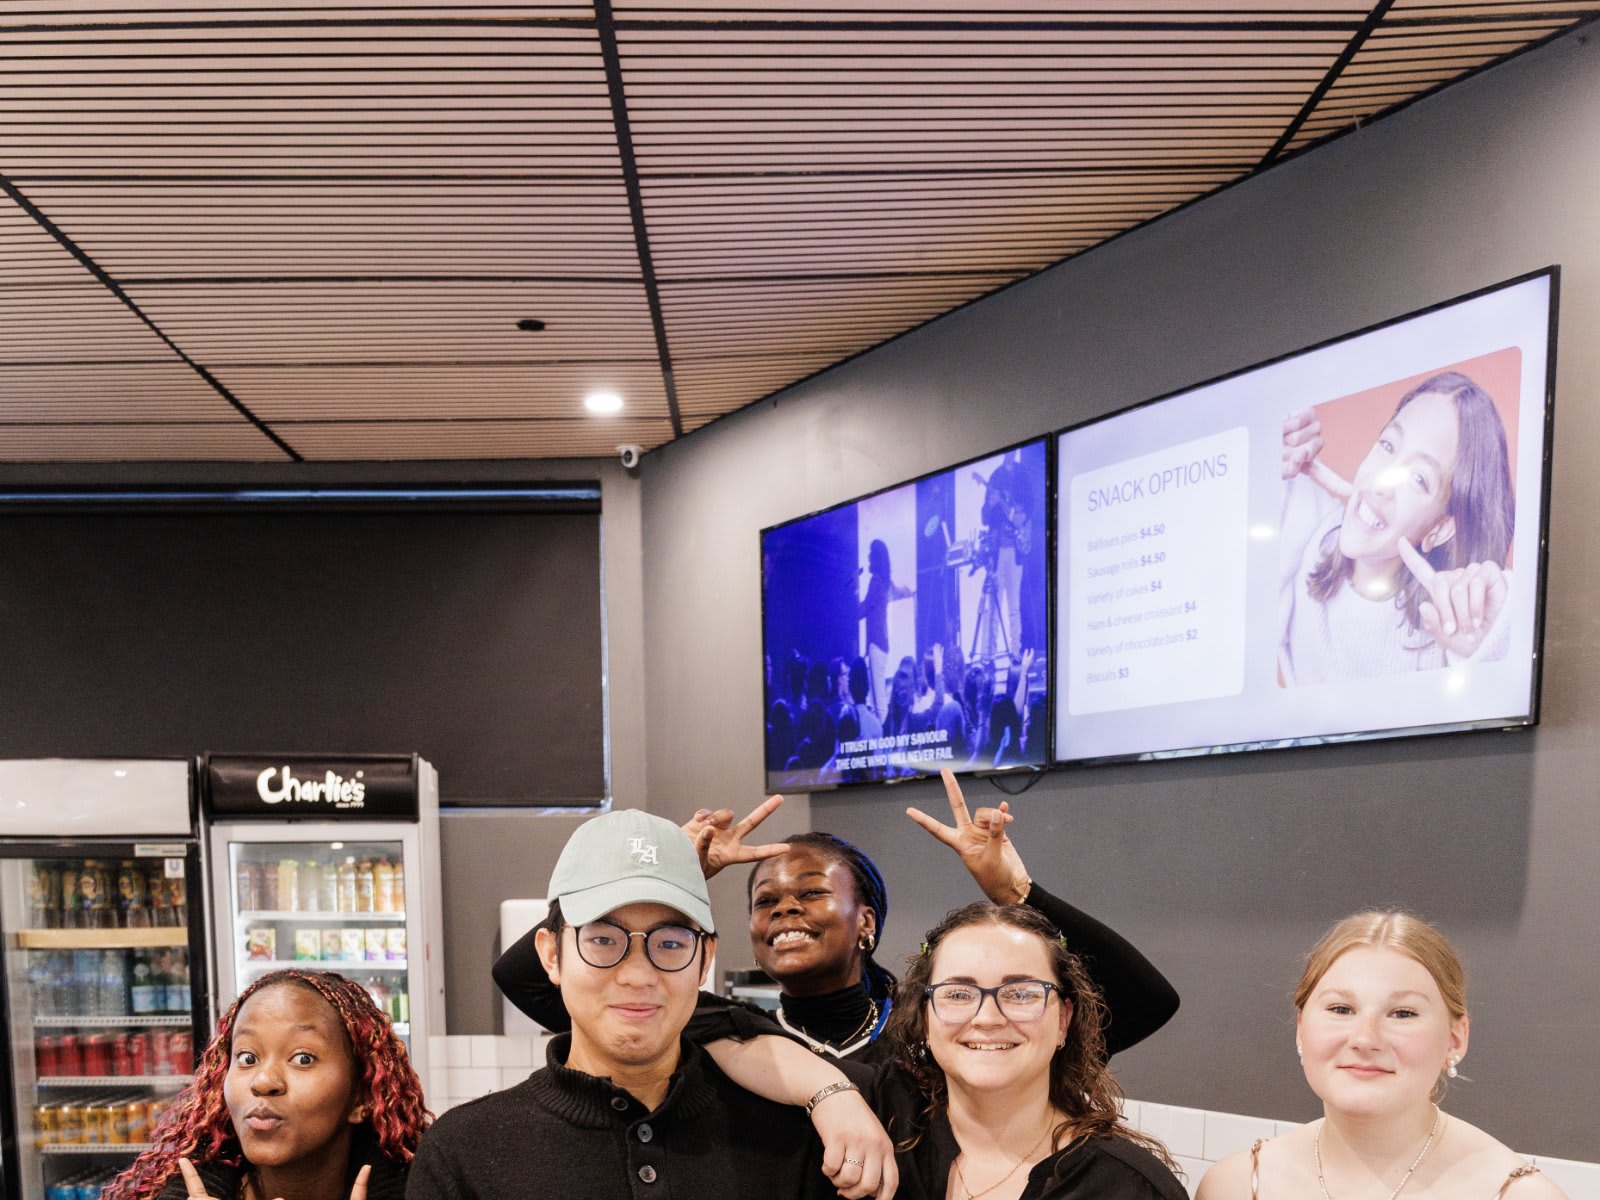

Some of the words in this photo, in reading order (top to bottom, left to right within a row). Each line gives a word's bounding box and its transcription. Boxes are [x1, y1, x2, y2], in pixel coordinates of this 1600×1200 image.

[1087, 477, 1144, 512] SNACK
[1148, 453, 1228, 496] OPTIONS
[1140, 523, 1165, 539] $4.50
[1088, 563, 1120, 578] Sausage
[1121, 558, 1139, 570] rolls
[1140, 551, 1165, 567] $4.50
[1087, 591, 1113, 605] Variety
[1115, 586, 1124, 600] of
[1151, 579, 1162, 592] $4
[1113, 613, 1142, 627] cheese
[1184, 600, 1197, 613] $4
[1087, 645, 1113, 657] Variety
[1115, 640, 1124, 653] of
[1125, 635, 1165, 651] chocolate
[1166, 632, 1185, 644] bars
[1186, 628, 1198, 641] $2
[1087, 670, 1117, 683] Biscuits
[1118, 666, 1129, 679] $3
[845, 740, 868, 753] TRUST
[869, 739, 878, 751] IN
[878, 736, 896, 749] GOD
[896, 735, 910, 747] MY
[910, 730, 948, 745] SAVIOUR
[835, 757, 850, 771] THE
[850, 756, 867, 769] ONE
[867, 754, 887, 767] WHO
[907, 748, 935, 762] NEVER
[935, 746, 954, 760] FAIL
[256, 765, 365, 804] Charlie's
[628, 837, 660, 865] LA
